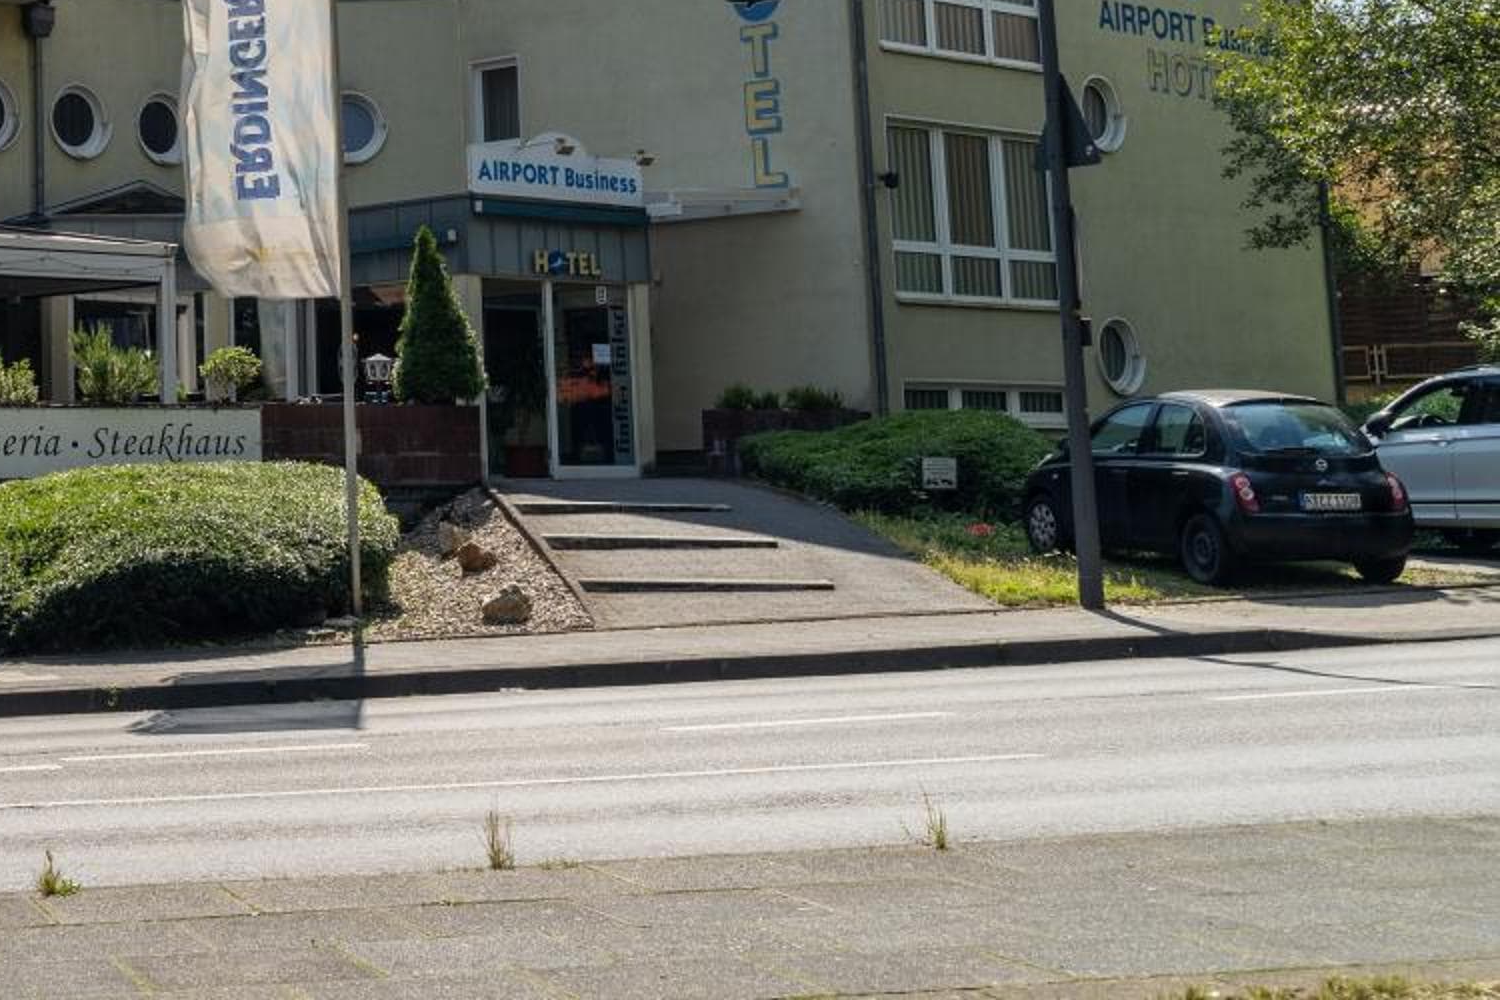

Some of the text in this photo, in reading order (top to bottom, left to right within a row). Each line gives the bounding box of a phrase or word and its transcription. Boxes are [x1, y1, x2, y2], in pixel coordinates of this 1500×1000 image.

[1099, 0, 1197, 43] AIRPORT
[478, 159, 638, 194] AIRPORT Business
[87, 423, 248, 462] Steakhaus
